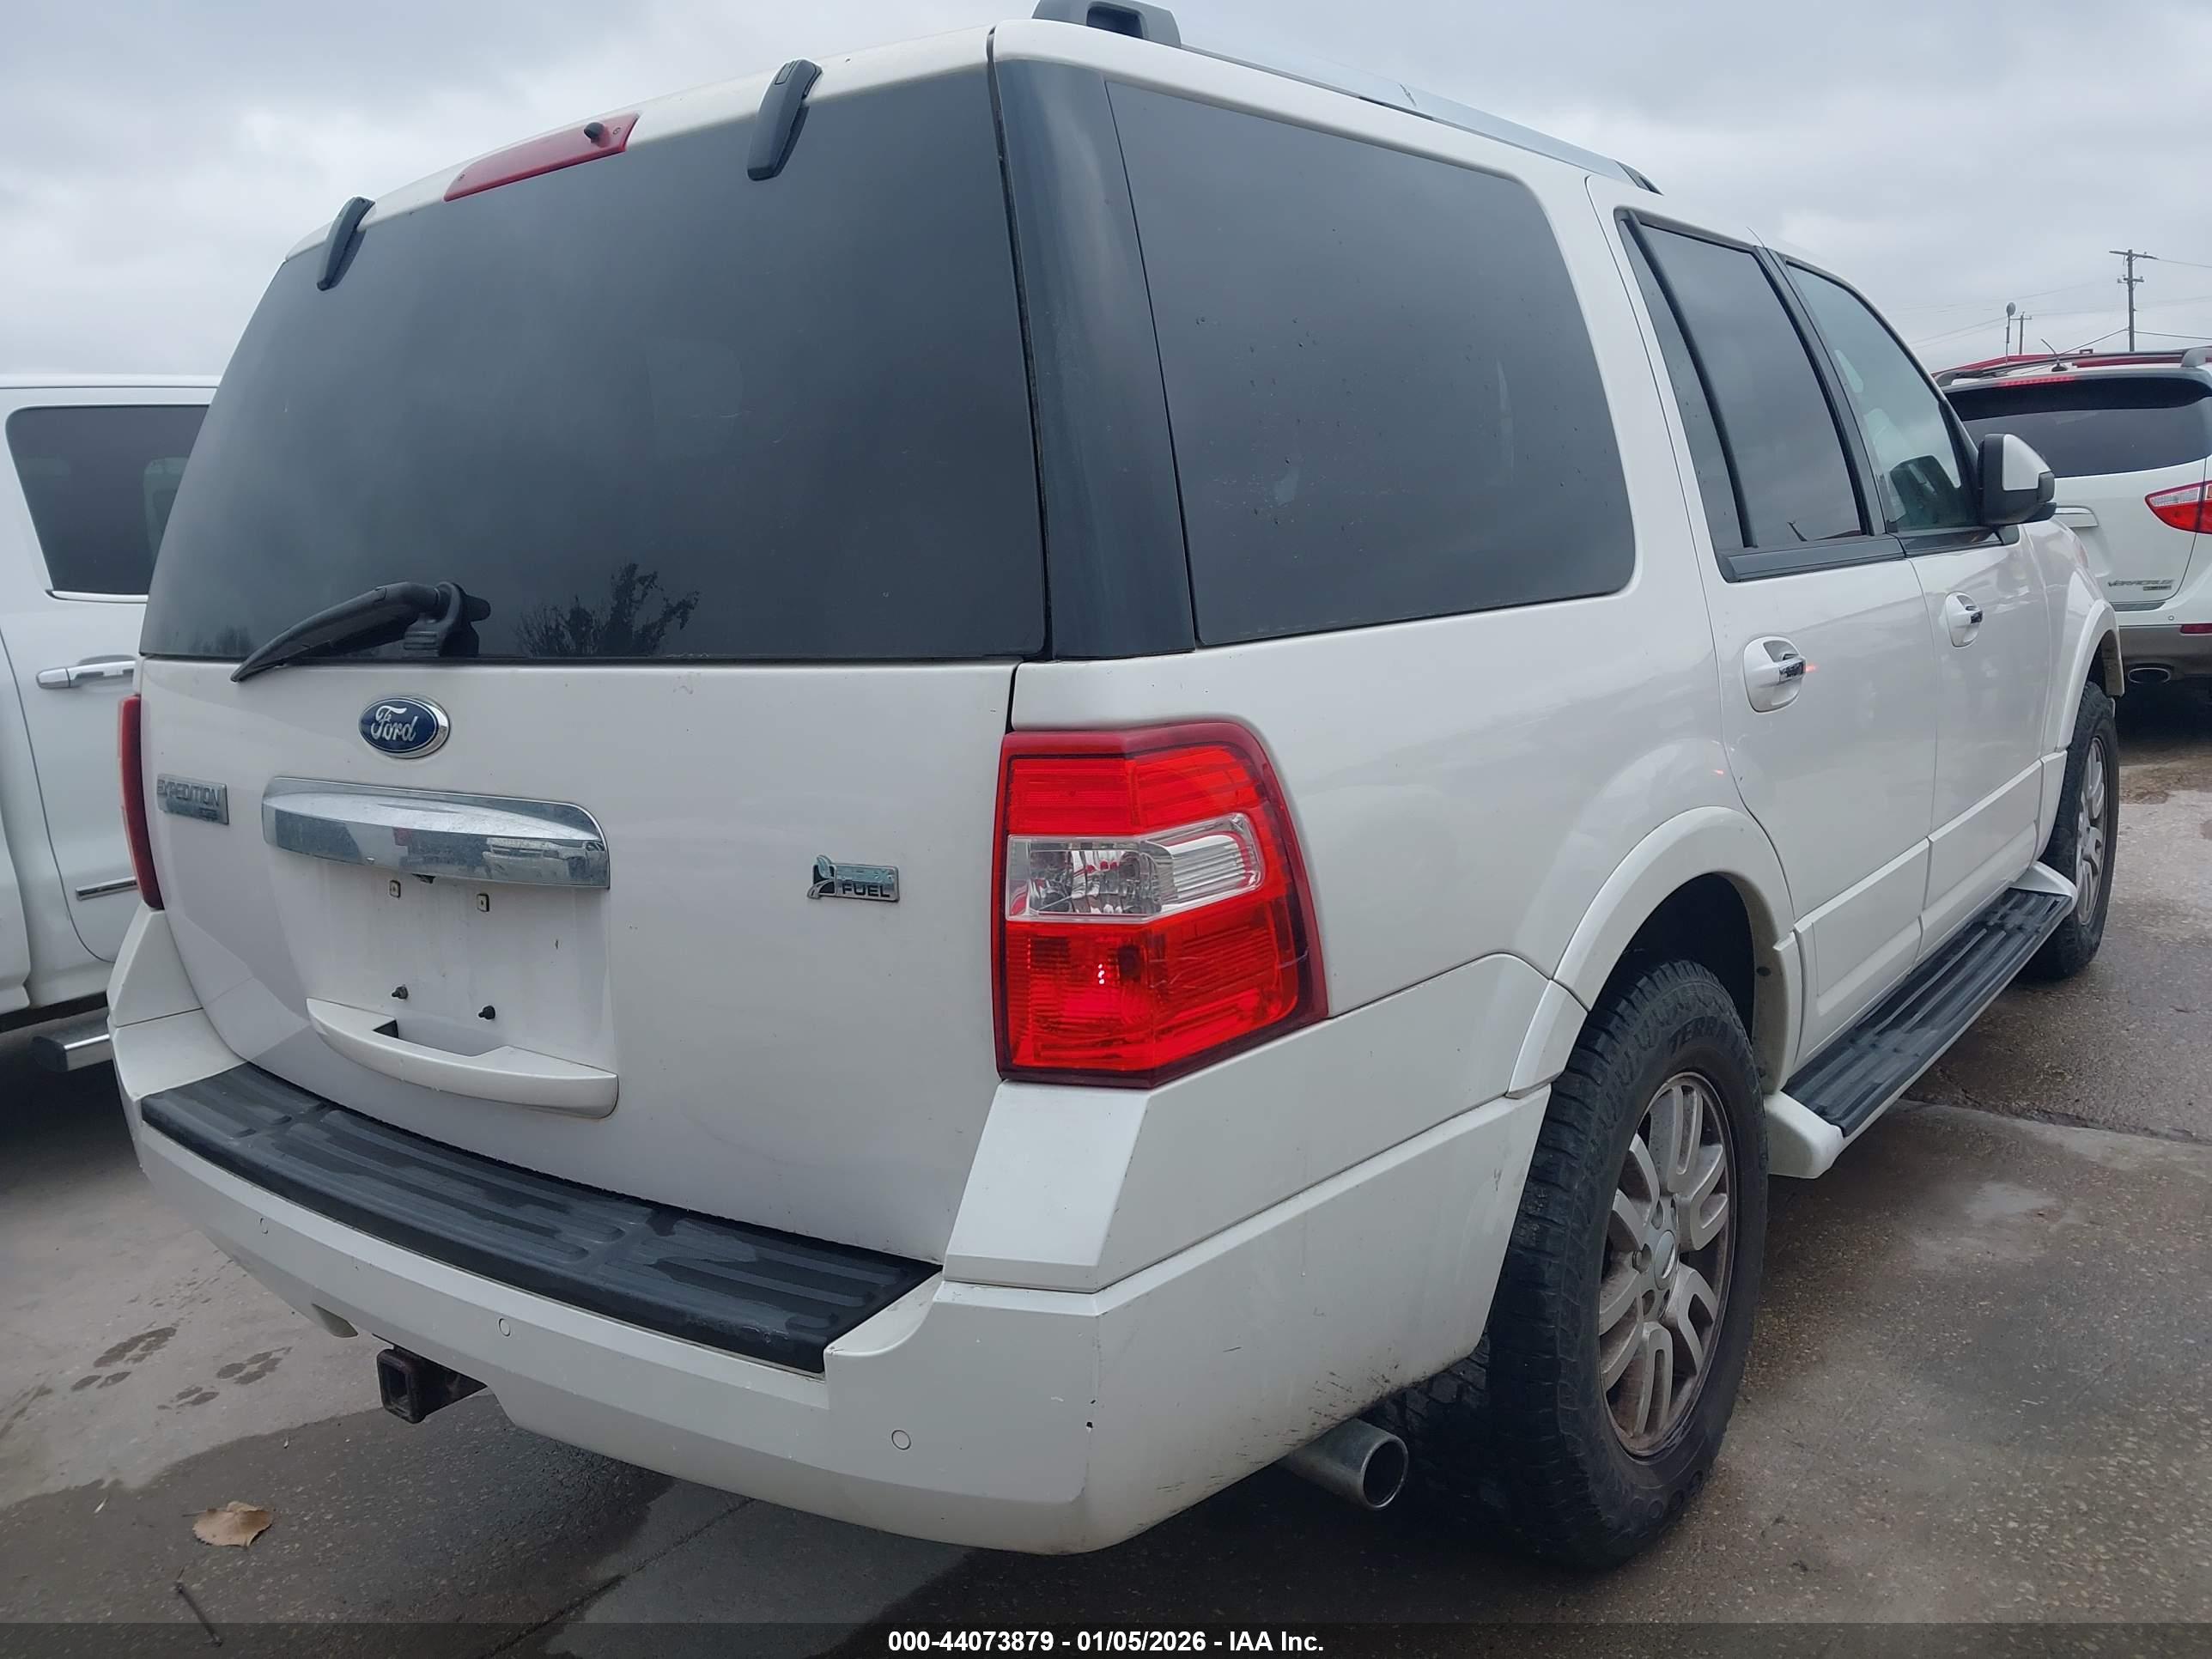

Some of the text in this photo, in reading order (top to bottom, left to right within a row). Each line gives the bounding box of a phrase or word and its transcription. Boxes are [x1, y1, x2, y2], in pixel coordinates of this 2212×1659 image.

[370, 704, 419, 742] Ford
[842, 878, 890, 898] FUEL
[1668, 1015, 1729, 1056] TERRA
